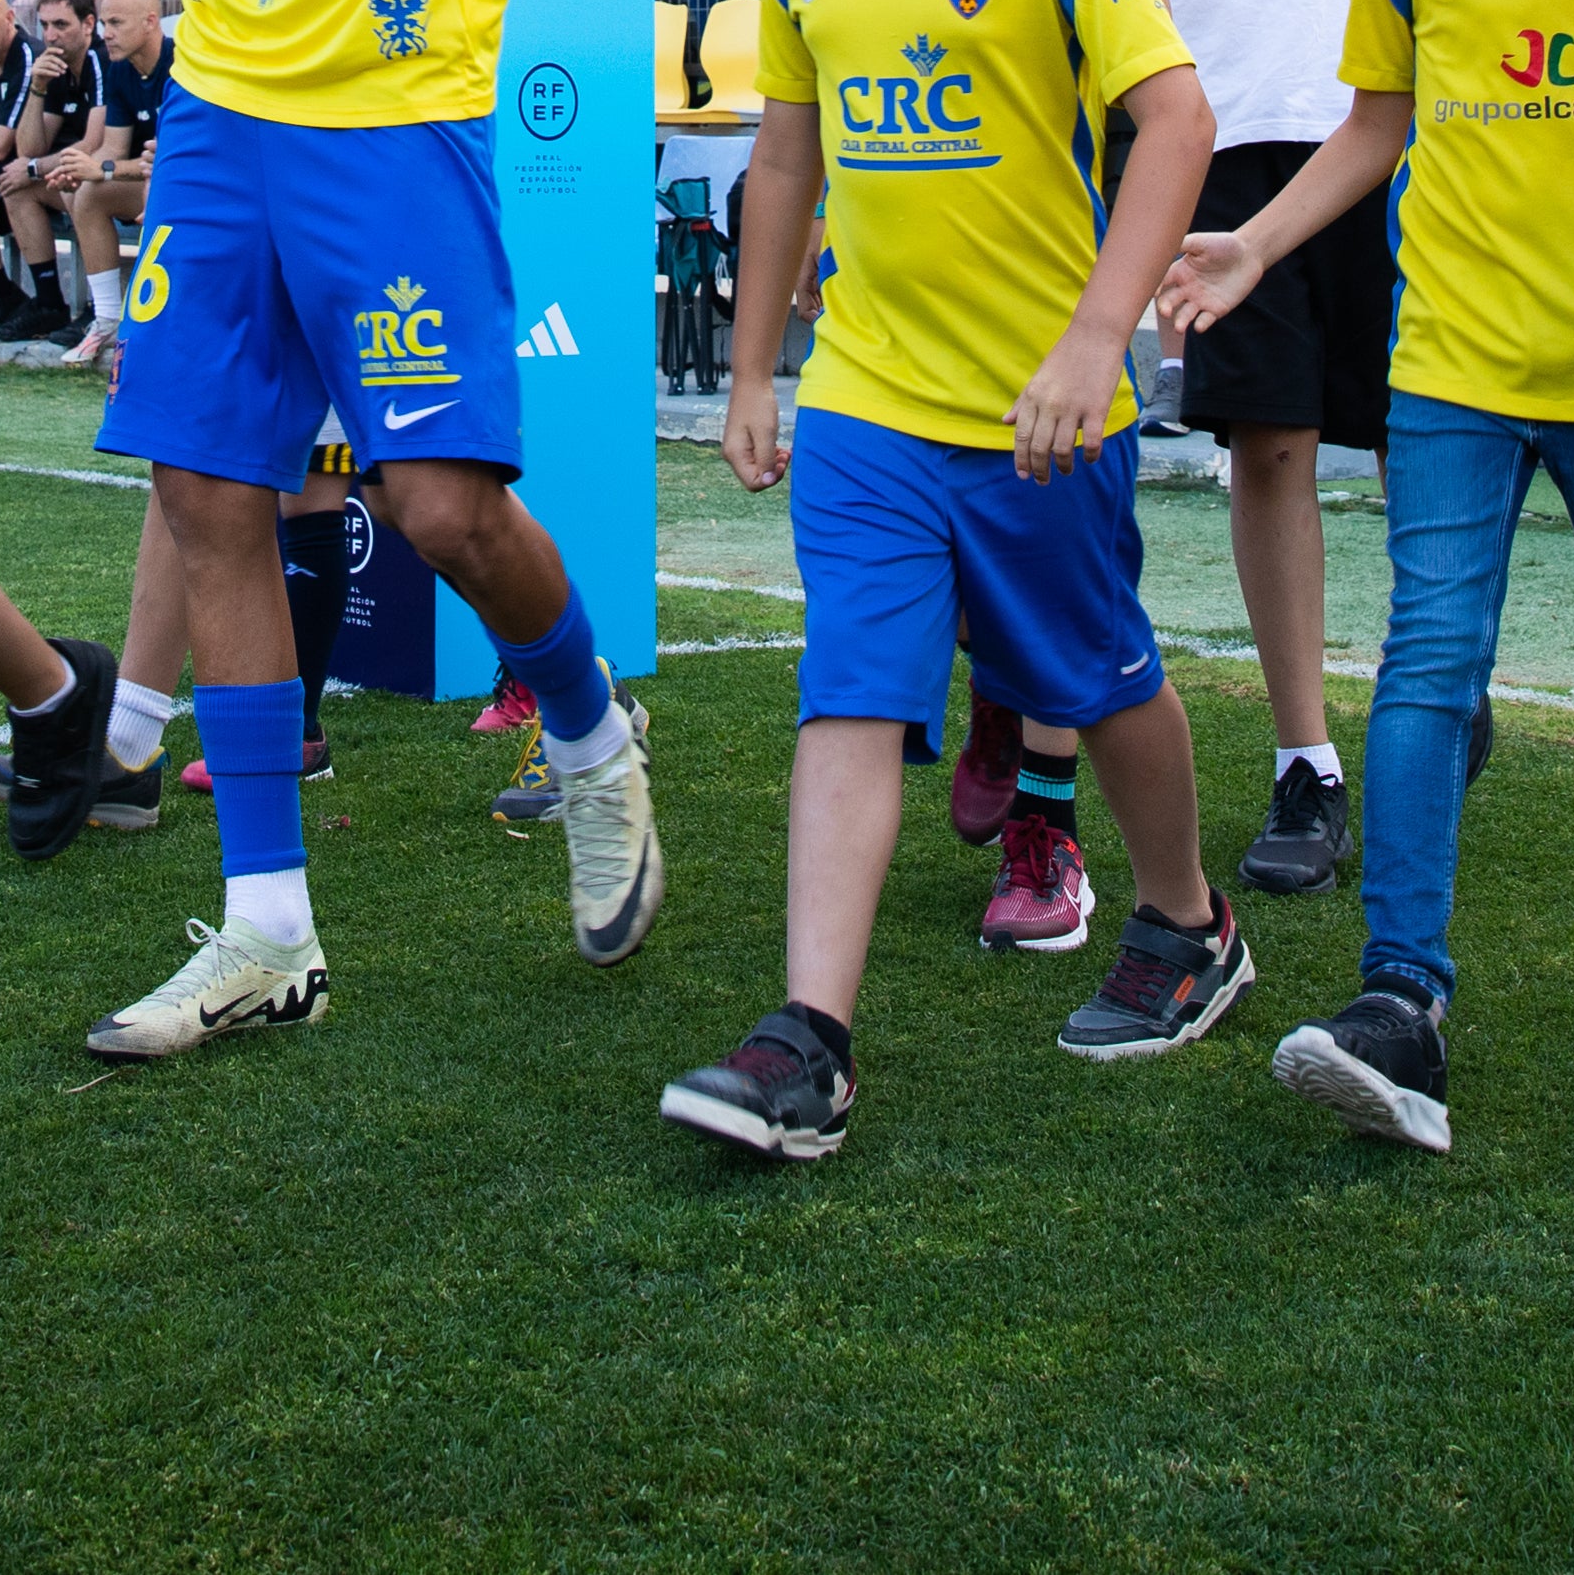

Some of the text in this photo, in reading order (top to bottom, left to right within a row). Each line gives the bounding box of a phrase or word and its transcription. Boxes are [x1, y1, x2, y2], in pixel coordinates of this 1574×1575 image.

[533, 83, 564, 98] RF
[838, 74, 981, 134] CRC
[533, 105, 564, 121] EF
[864, 140, 910, 153] RURAL
[911, 139, 983, 152] CENTRAL
[514, 164, 582, 172] FEDERACIÓN
[520, 175, 576, 183] ESPAÑOLA
